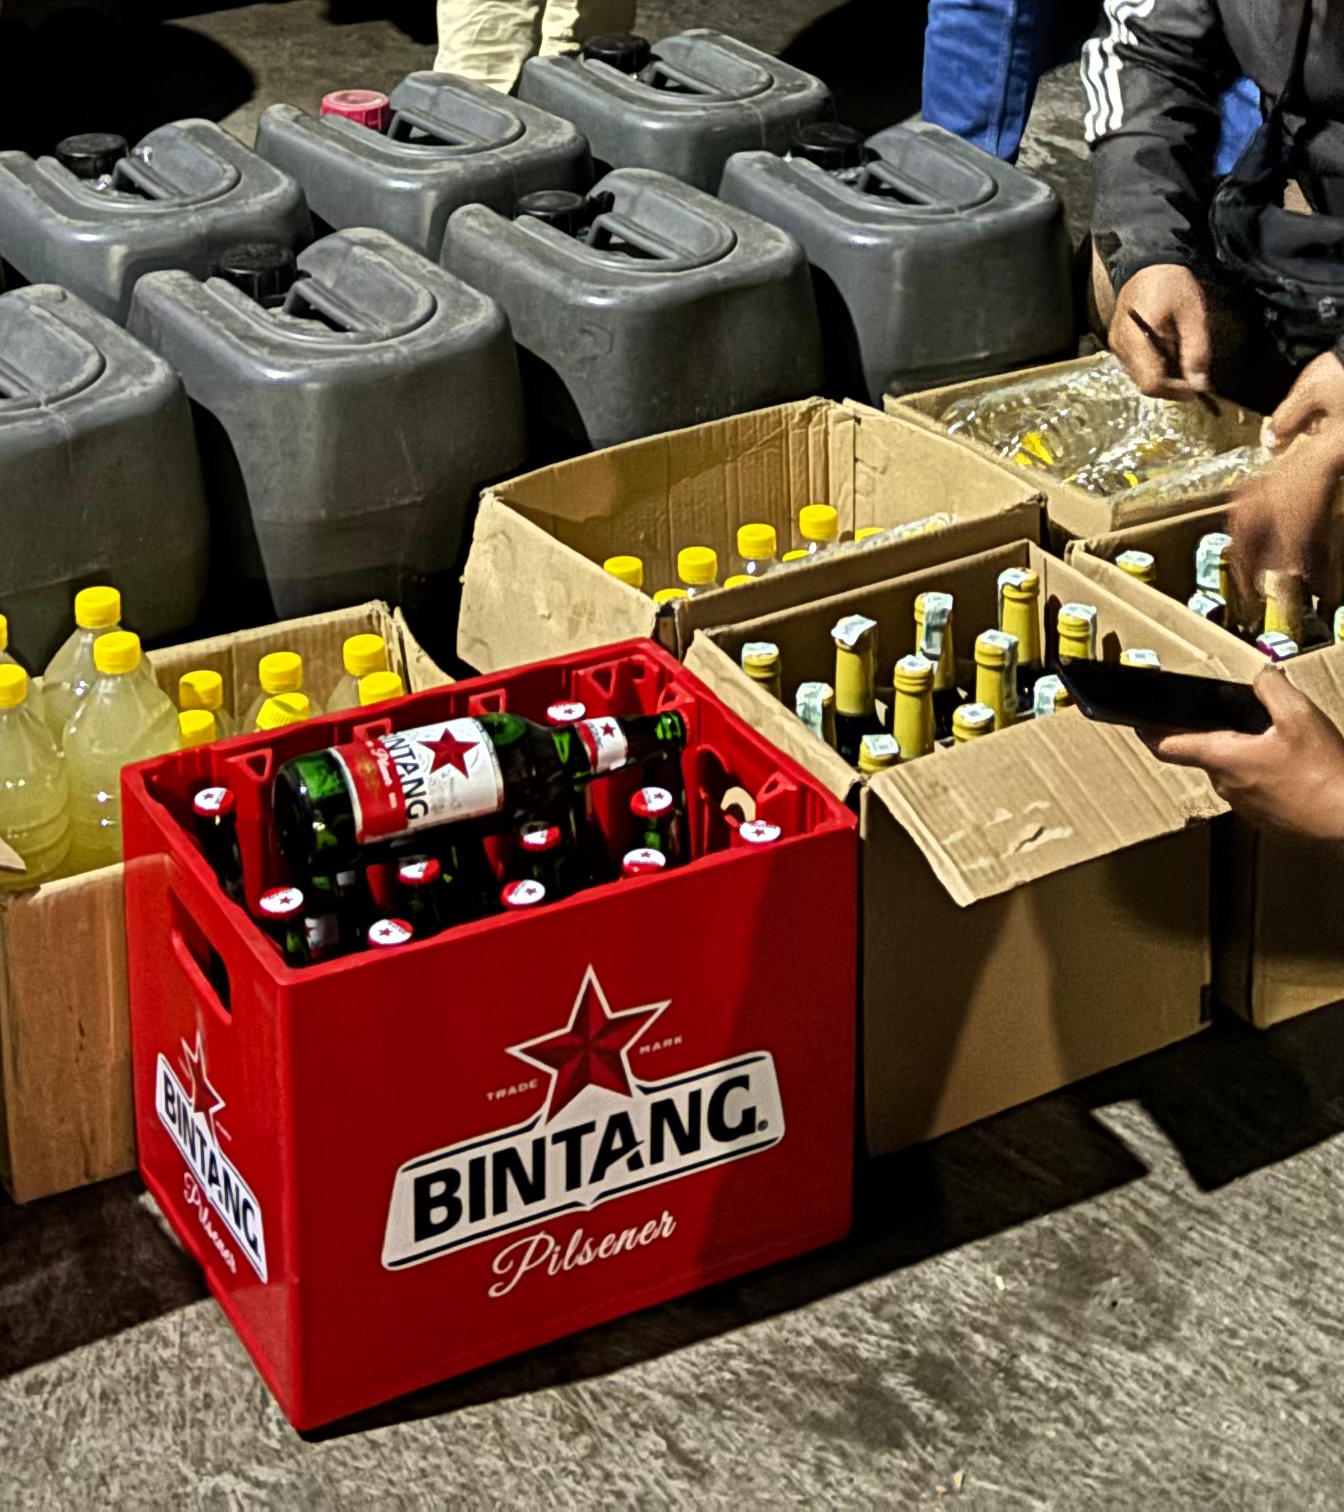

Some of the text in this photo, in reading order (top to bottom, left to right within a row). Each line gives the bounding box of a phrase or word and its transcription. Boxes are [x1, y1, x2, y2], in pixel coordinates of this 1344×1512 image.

[638, 1035, 684, 1055] MARK
[485, 1079, 539, 1102] TRADE
[163, 1069, 262, 1263] BINTANG
[413, 1074, 758, 1243] BINTANG
[487, 1209, 677, 1299] Pilsener
